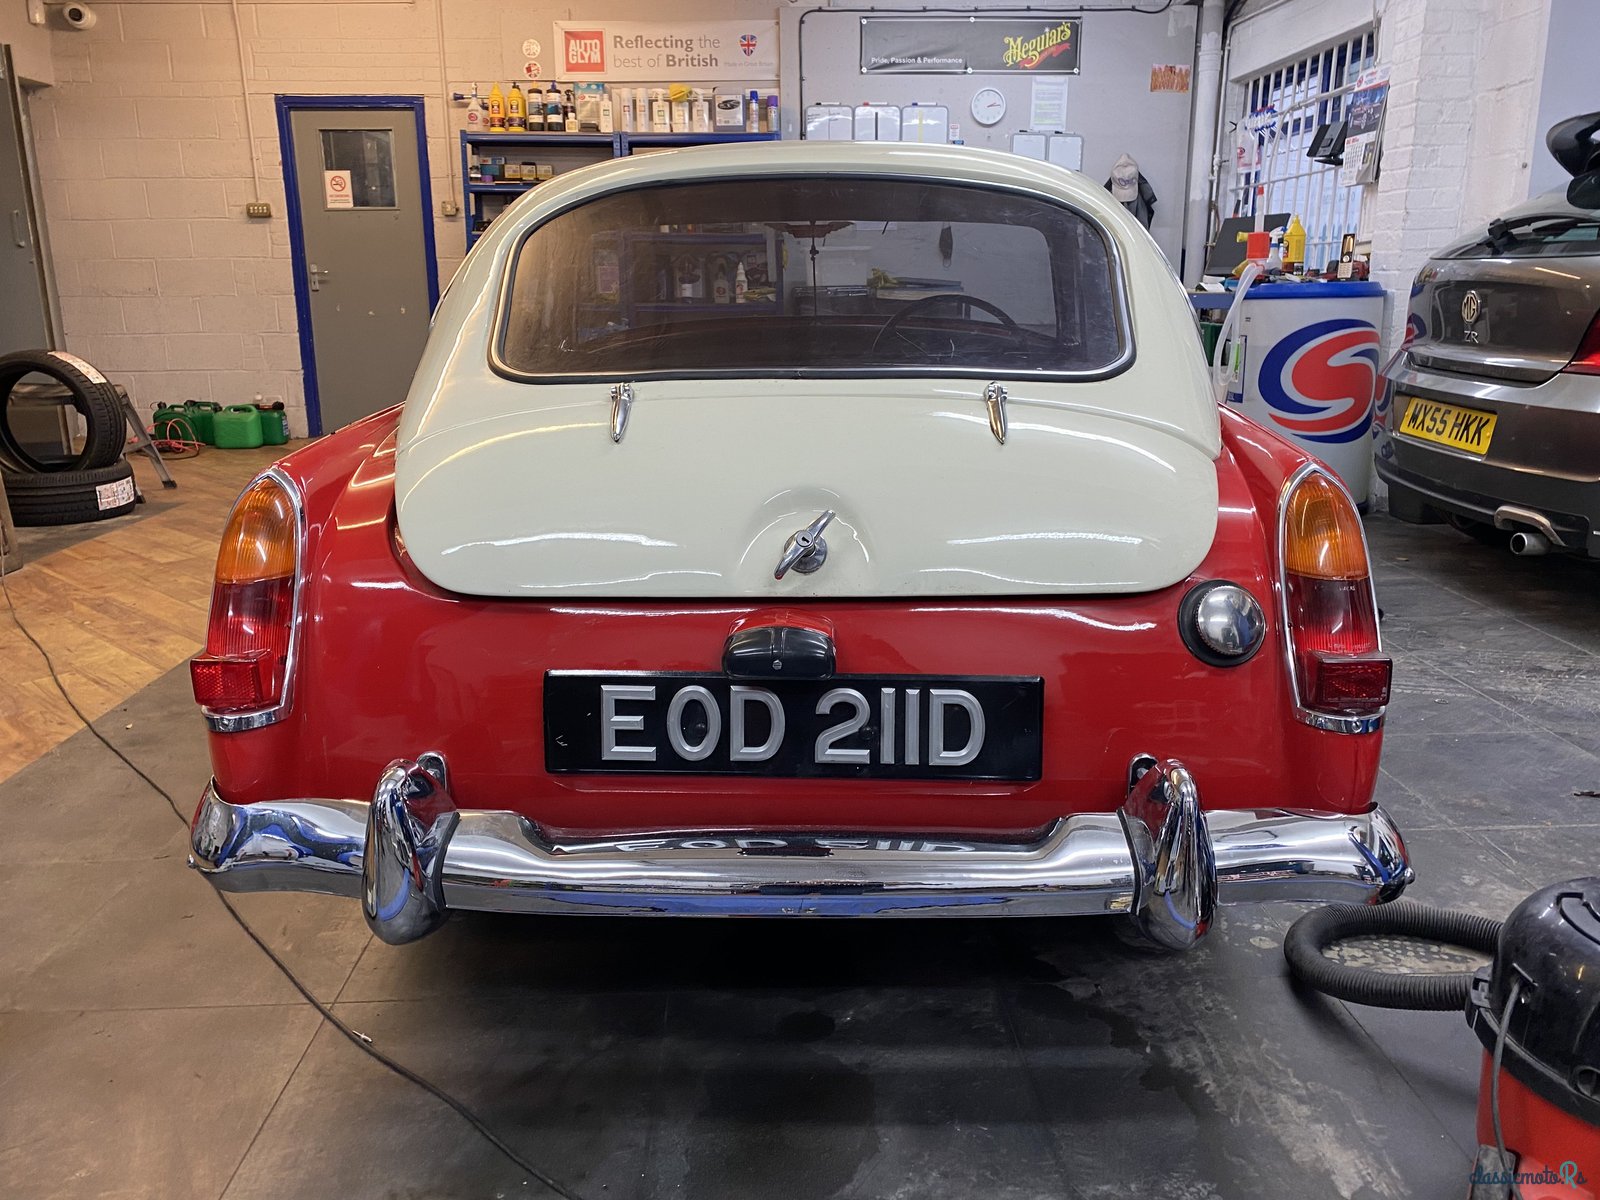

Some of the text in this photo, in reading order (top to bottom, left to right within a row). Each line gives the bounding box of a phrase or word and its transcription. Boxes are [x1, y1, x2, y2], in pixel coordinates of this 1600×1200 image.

[568, 39, 601, 51] AUTO
[613, 35, 721, 52] Reflecting the
[1003, 21, 1072, 68] Meguiar's
[568, 51, 601, 64] GLYM
[613, 54, 719, 68] best of British
[871, 57, 889, 65] Pride,
[1463, 294, 1478, 321] MG
[1464, 330, 1479, 344] ZR
[1407, 402, 1491, 447] MX55 HKK
[600, 685, 986, 766] EOD 211D
